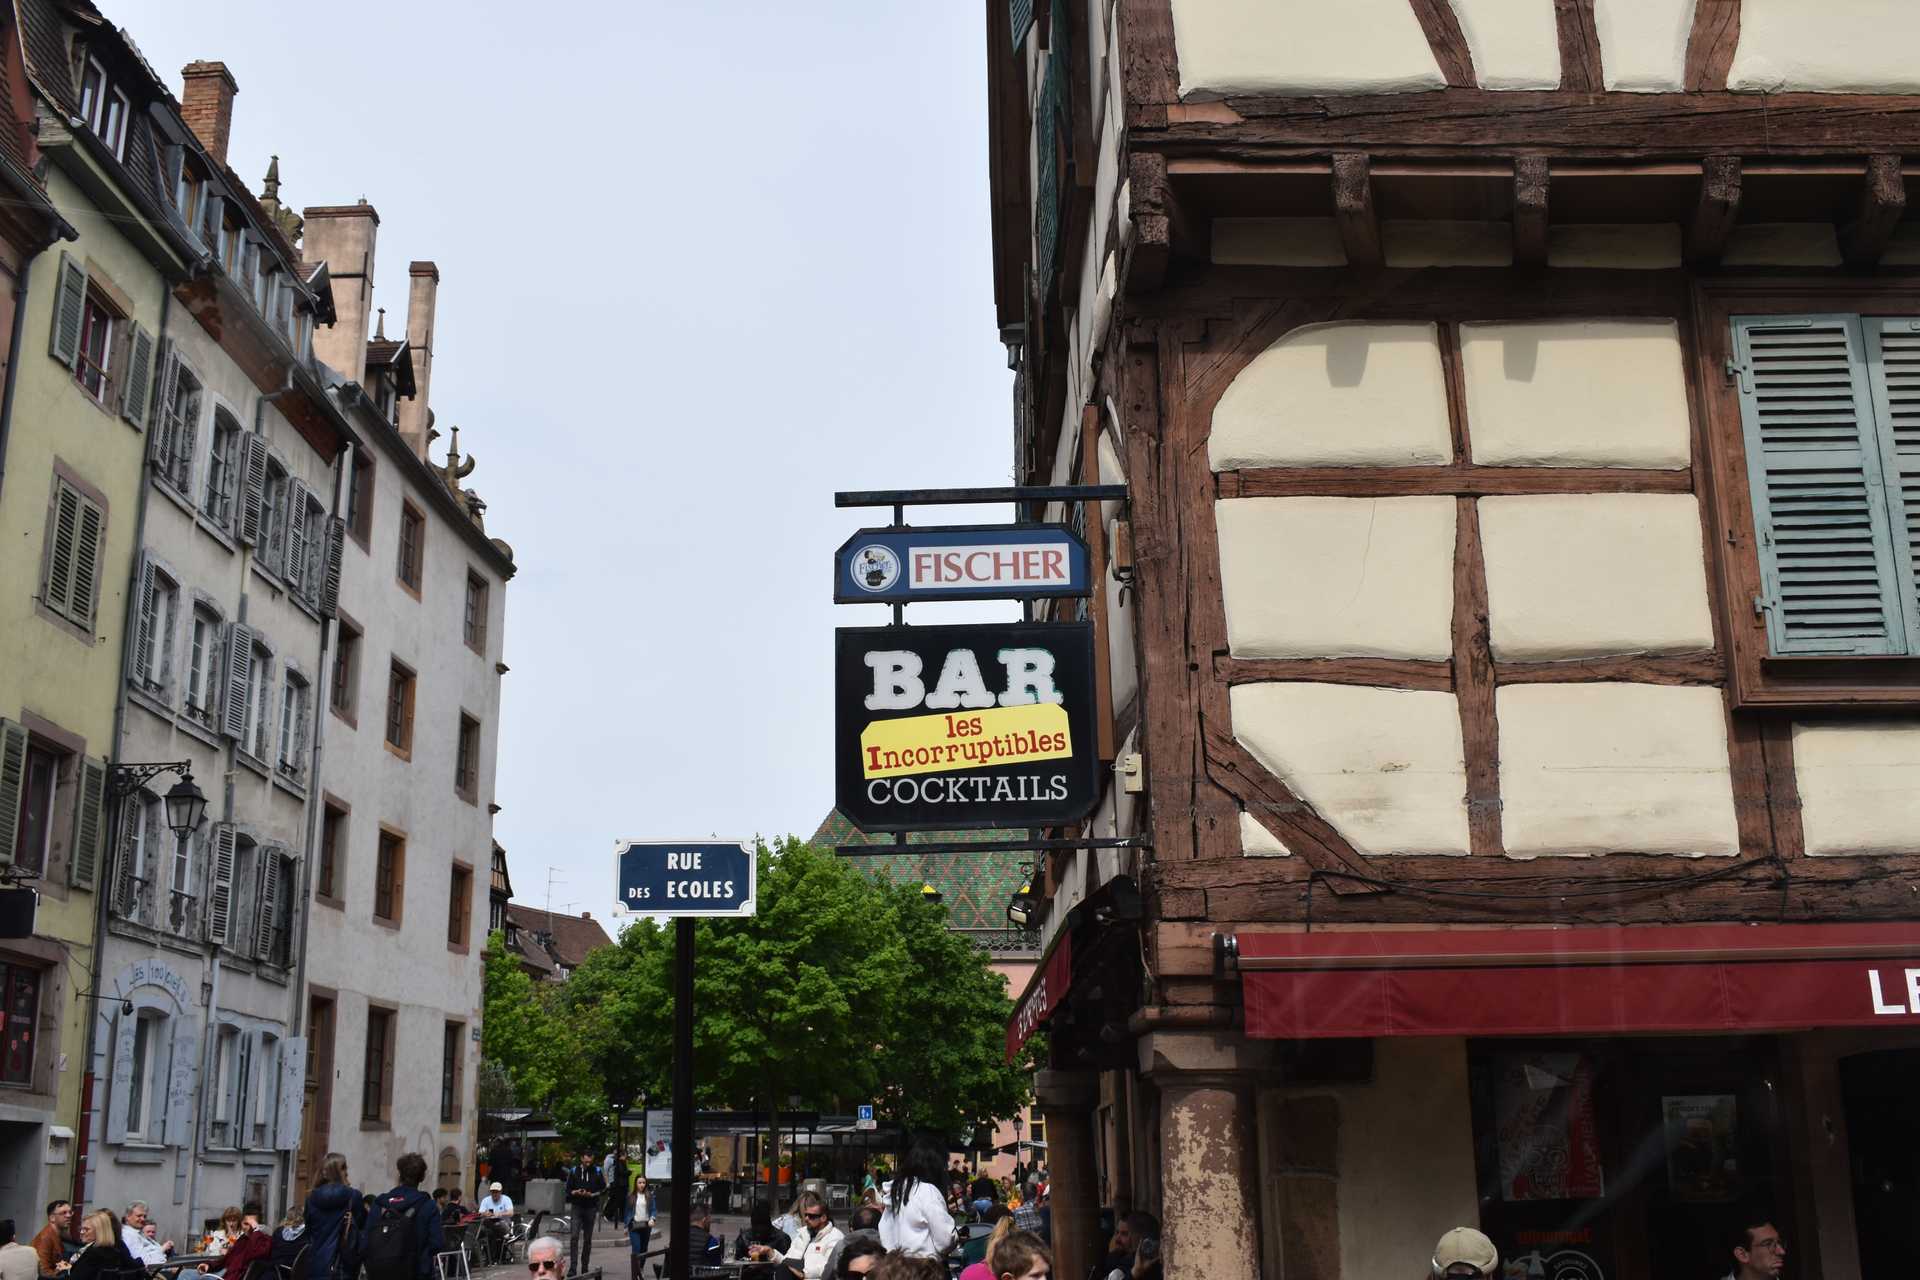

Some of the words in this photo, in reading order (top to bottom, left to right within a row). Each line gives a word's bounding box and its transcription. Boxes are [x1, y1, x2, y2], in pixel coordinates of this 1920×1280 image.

[914, 550, 1066, 583] FISCHER
[864, 648, 1064, 710] BAR
[945, 715, 983, 739] les
[867, 731, 1066, 771] Incorruptibles
[867, 775, 1069, 805] COCKTAILS
[667, 852, 702, 870] RUE
[628, 887, 651, 899] DES
[666, 880, 734, 899] ECOLES
